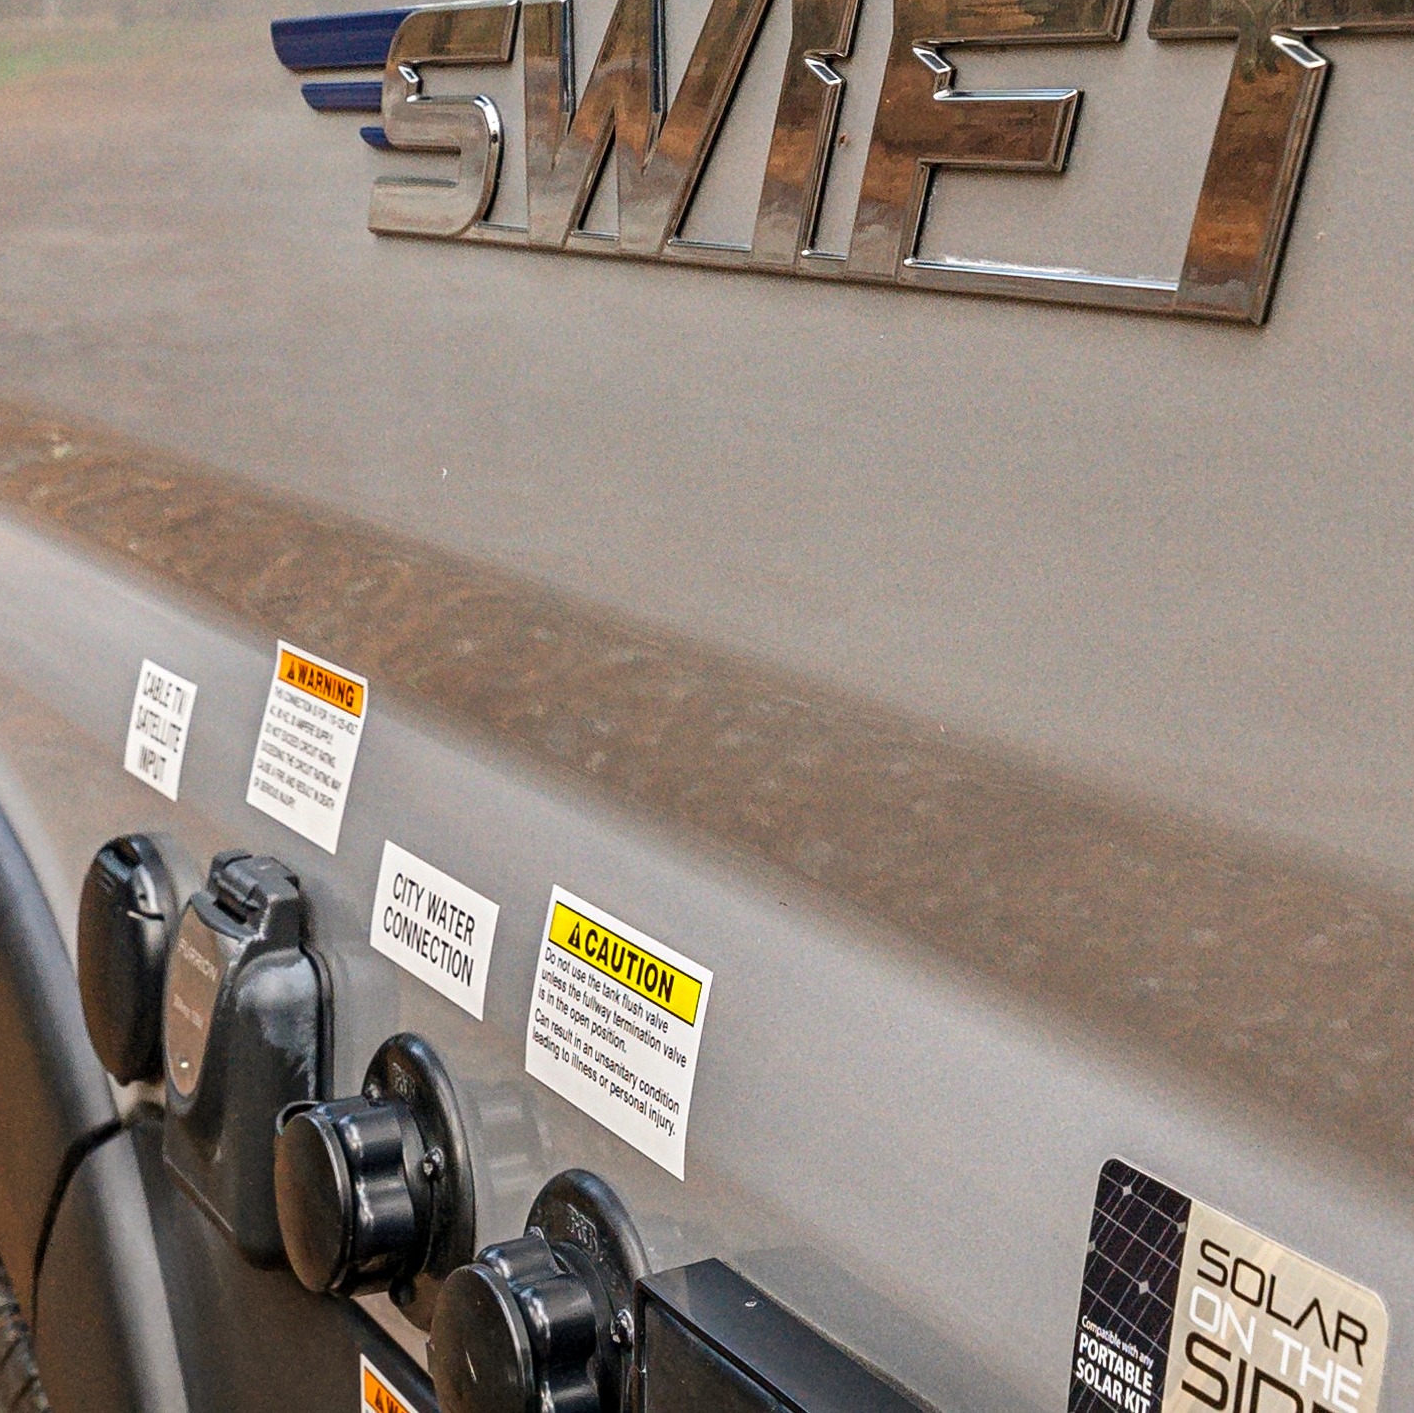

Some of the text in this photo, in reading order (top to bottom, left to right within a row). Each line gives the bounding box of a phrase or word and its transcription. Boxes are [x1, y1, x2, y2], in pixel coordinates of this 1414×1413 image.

[298, 662, 355, 708] WARNING
[383, 906, 475, 988] CONNECTION
[392, 872, 476, 947] CITY WATER
[545, 947, 669, 1033] Do not use the tank flush valve
[585, 929, 675, 1003] CAUTION
[538, 984, 627, 1053] is in the open position.
[542, 969, 687, 1067] unless the fullway termination valve
[532, 1026, 676, 1137] leading to illness or personal injury.
[535, 1008, 680, 1115] Can result in an unsanitary condition
[1081, 1315, 1154, 1370] Compatible with any
[1197, 1239, 1369, 1367] SOLAR
[1075, 1357, 1151, 1413] SOLAR KIT
[1078, 1332, 1153, 1396] PORTABLE
[1181, 1331, 1339, 1413] SID
[1189, 1286, 1363, 1413] ON THE
